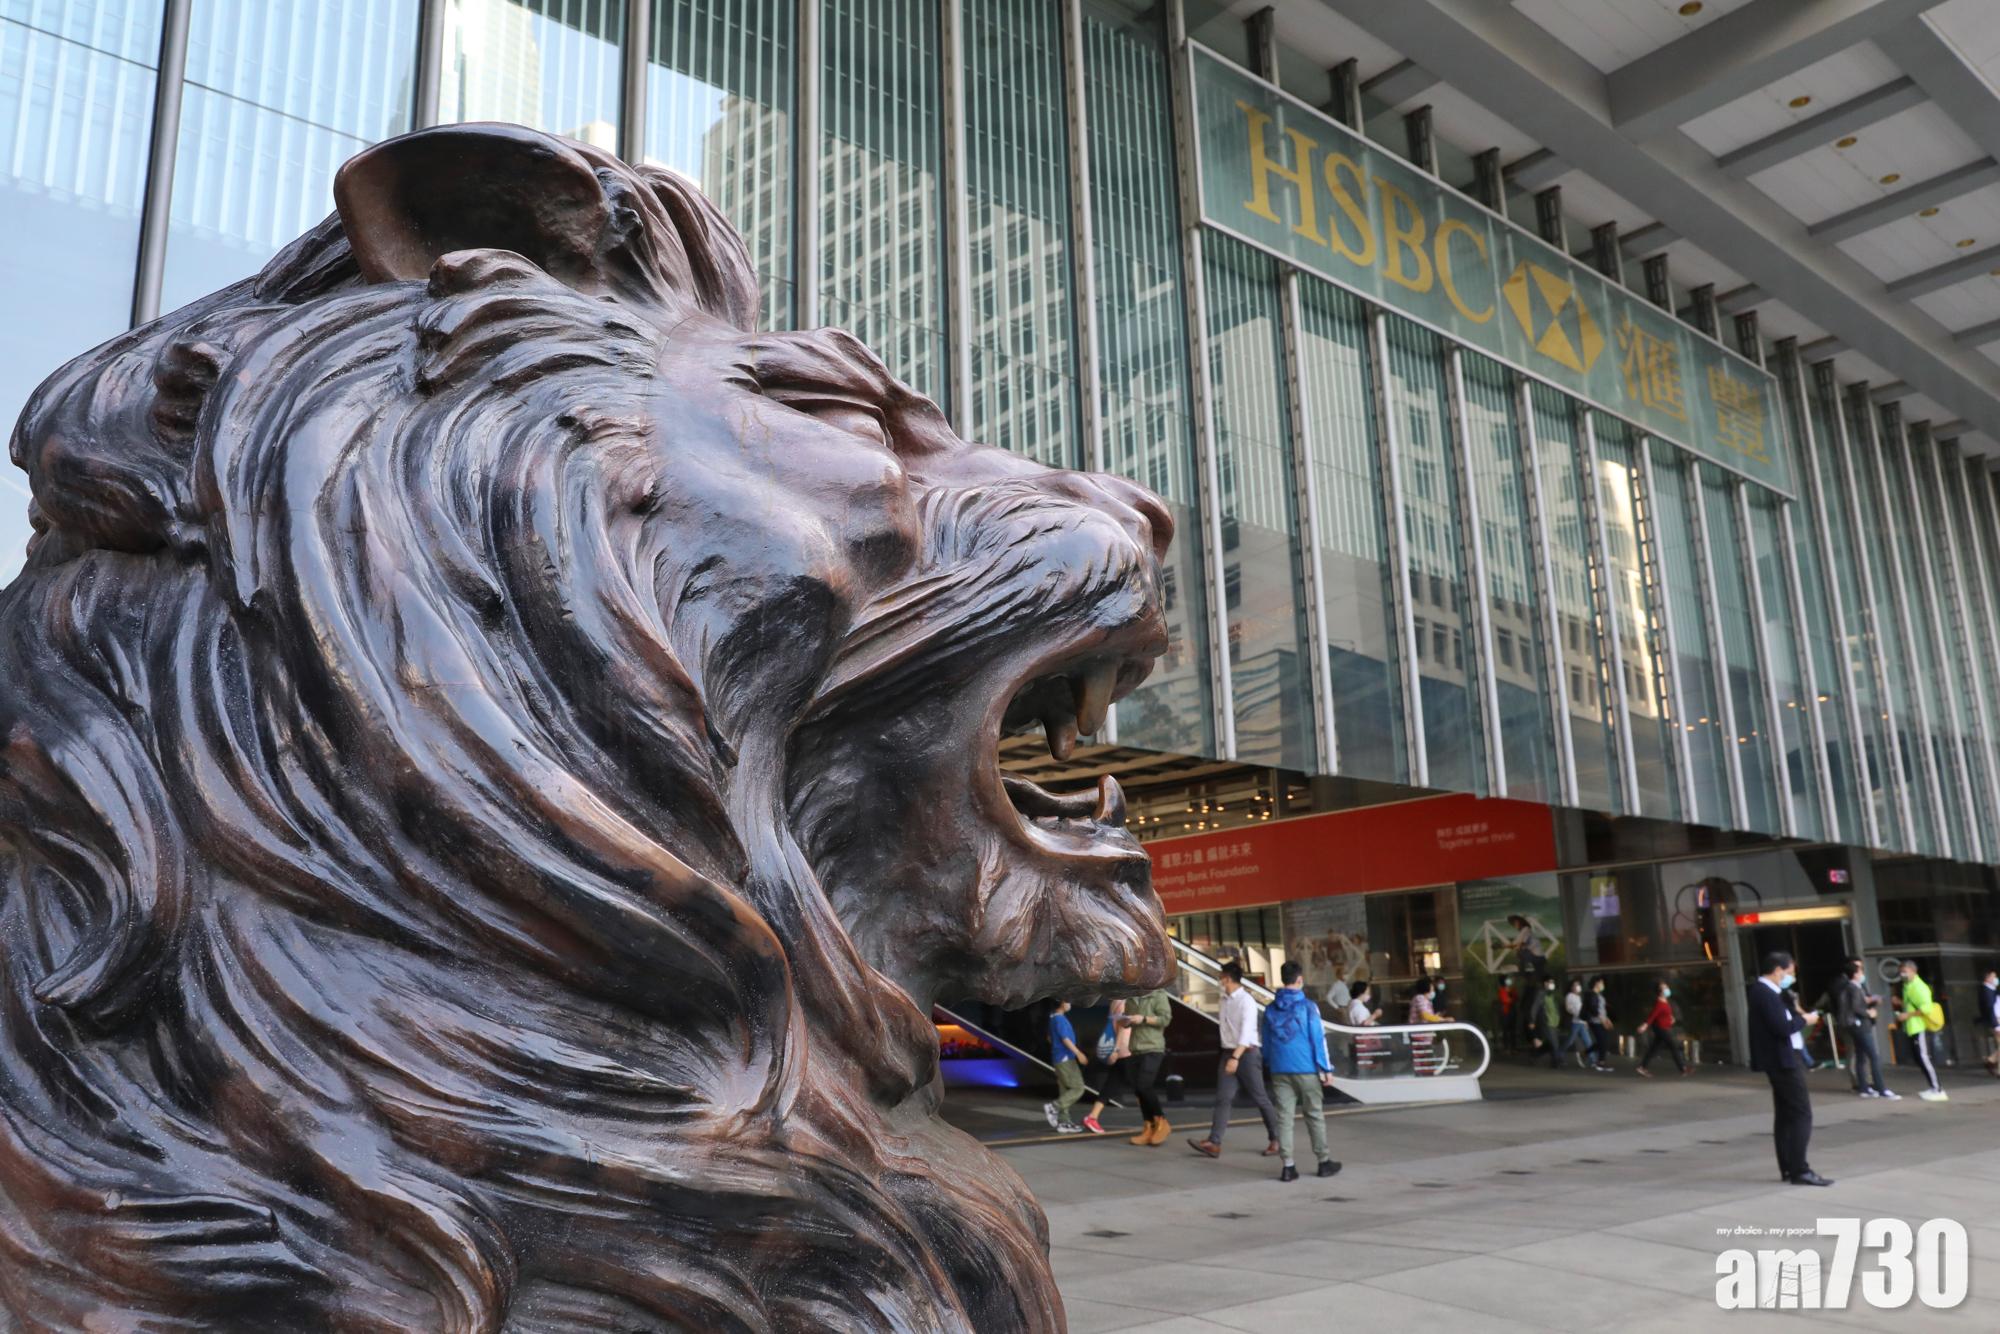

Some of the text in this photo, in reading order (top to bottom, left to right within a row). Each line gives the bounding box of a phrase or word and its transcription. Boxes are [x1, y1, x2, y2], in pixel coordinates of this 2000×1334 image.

[1235, 100, 1496, 324] HSBC
[1152, 864, 1259, 888] ngkong Bank Foundation
[1160, 887, 1196, 899] mmunity
